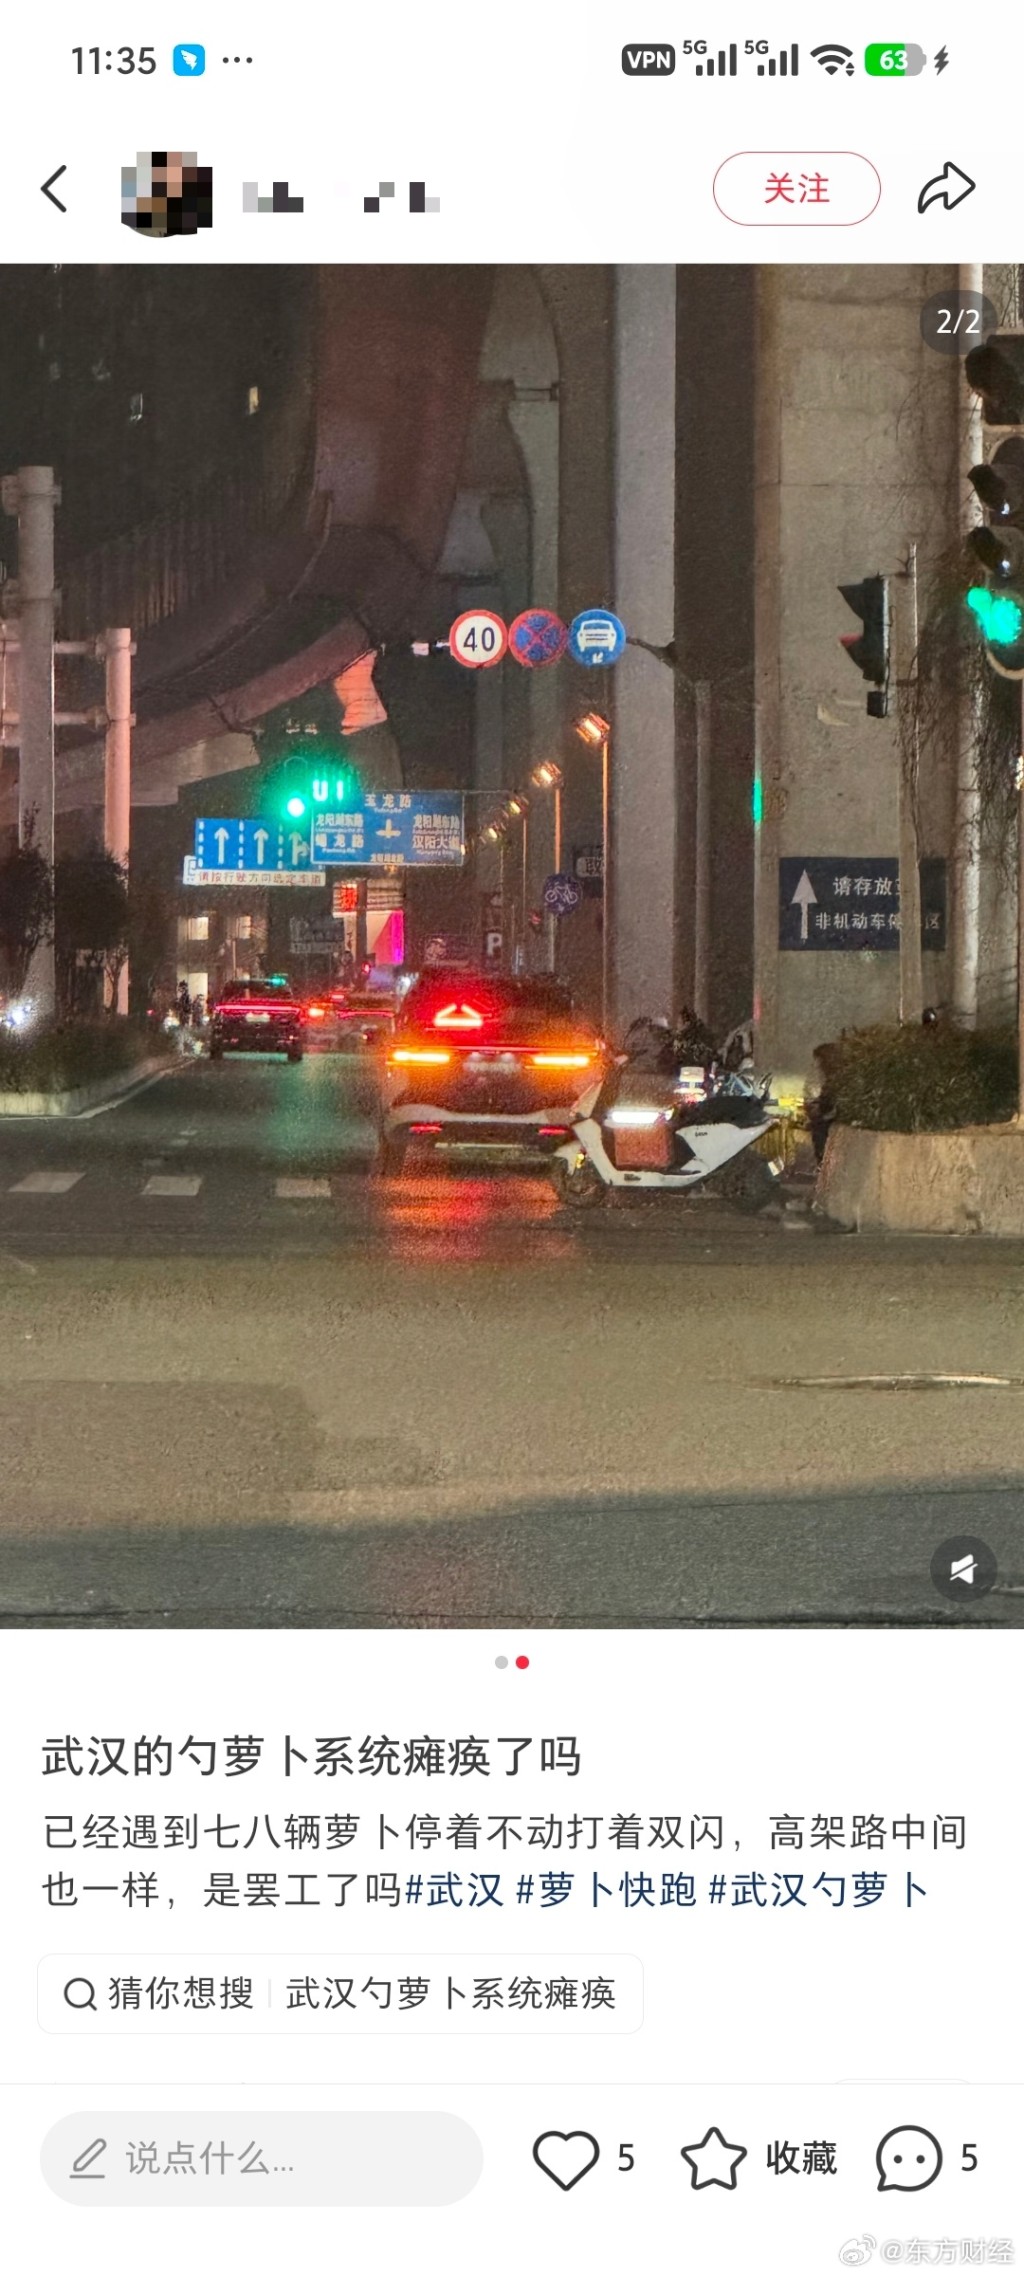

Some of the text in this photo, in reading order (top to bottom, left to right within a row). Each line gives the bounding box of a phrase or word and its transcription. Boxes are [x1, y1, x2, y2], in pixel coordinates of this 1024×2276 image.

[71, 46, 156, 75] 11:35
[627, 51, 670, 69] VPN
[682, 40, 708, 55] 5G
[744, 40, 769, 55] 5G
[880, 51, 909, 70] 63
[764, 171, 830, 204] 关注
[463, 627, 495, 651] 40
[815, 912, 941, 930] 非机动车停区
[41, 1734, 581, 1778] 武汉的勺萝卜系统瘫痪了吗
[44, 1812, 966, 1852] 已经遇到七八辆萝卜停着不动打着双闪，高架路中间
[515, 1870, 697, 1908] #萝卜快跑
[708, 1870, 927, 1908] #武汉勺萝卜
[108, 1975, 254, 2010] 猜你想搜
[286, 1975, 616, 2011] 武汉勺萝卜系统瘫痪
[618, 2143, 635, 2172] 5
[766, 2139, 838, 2176] 收藏
[961, 2143, 978, 2172] 5
